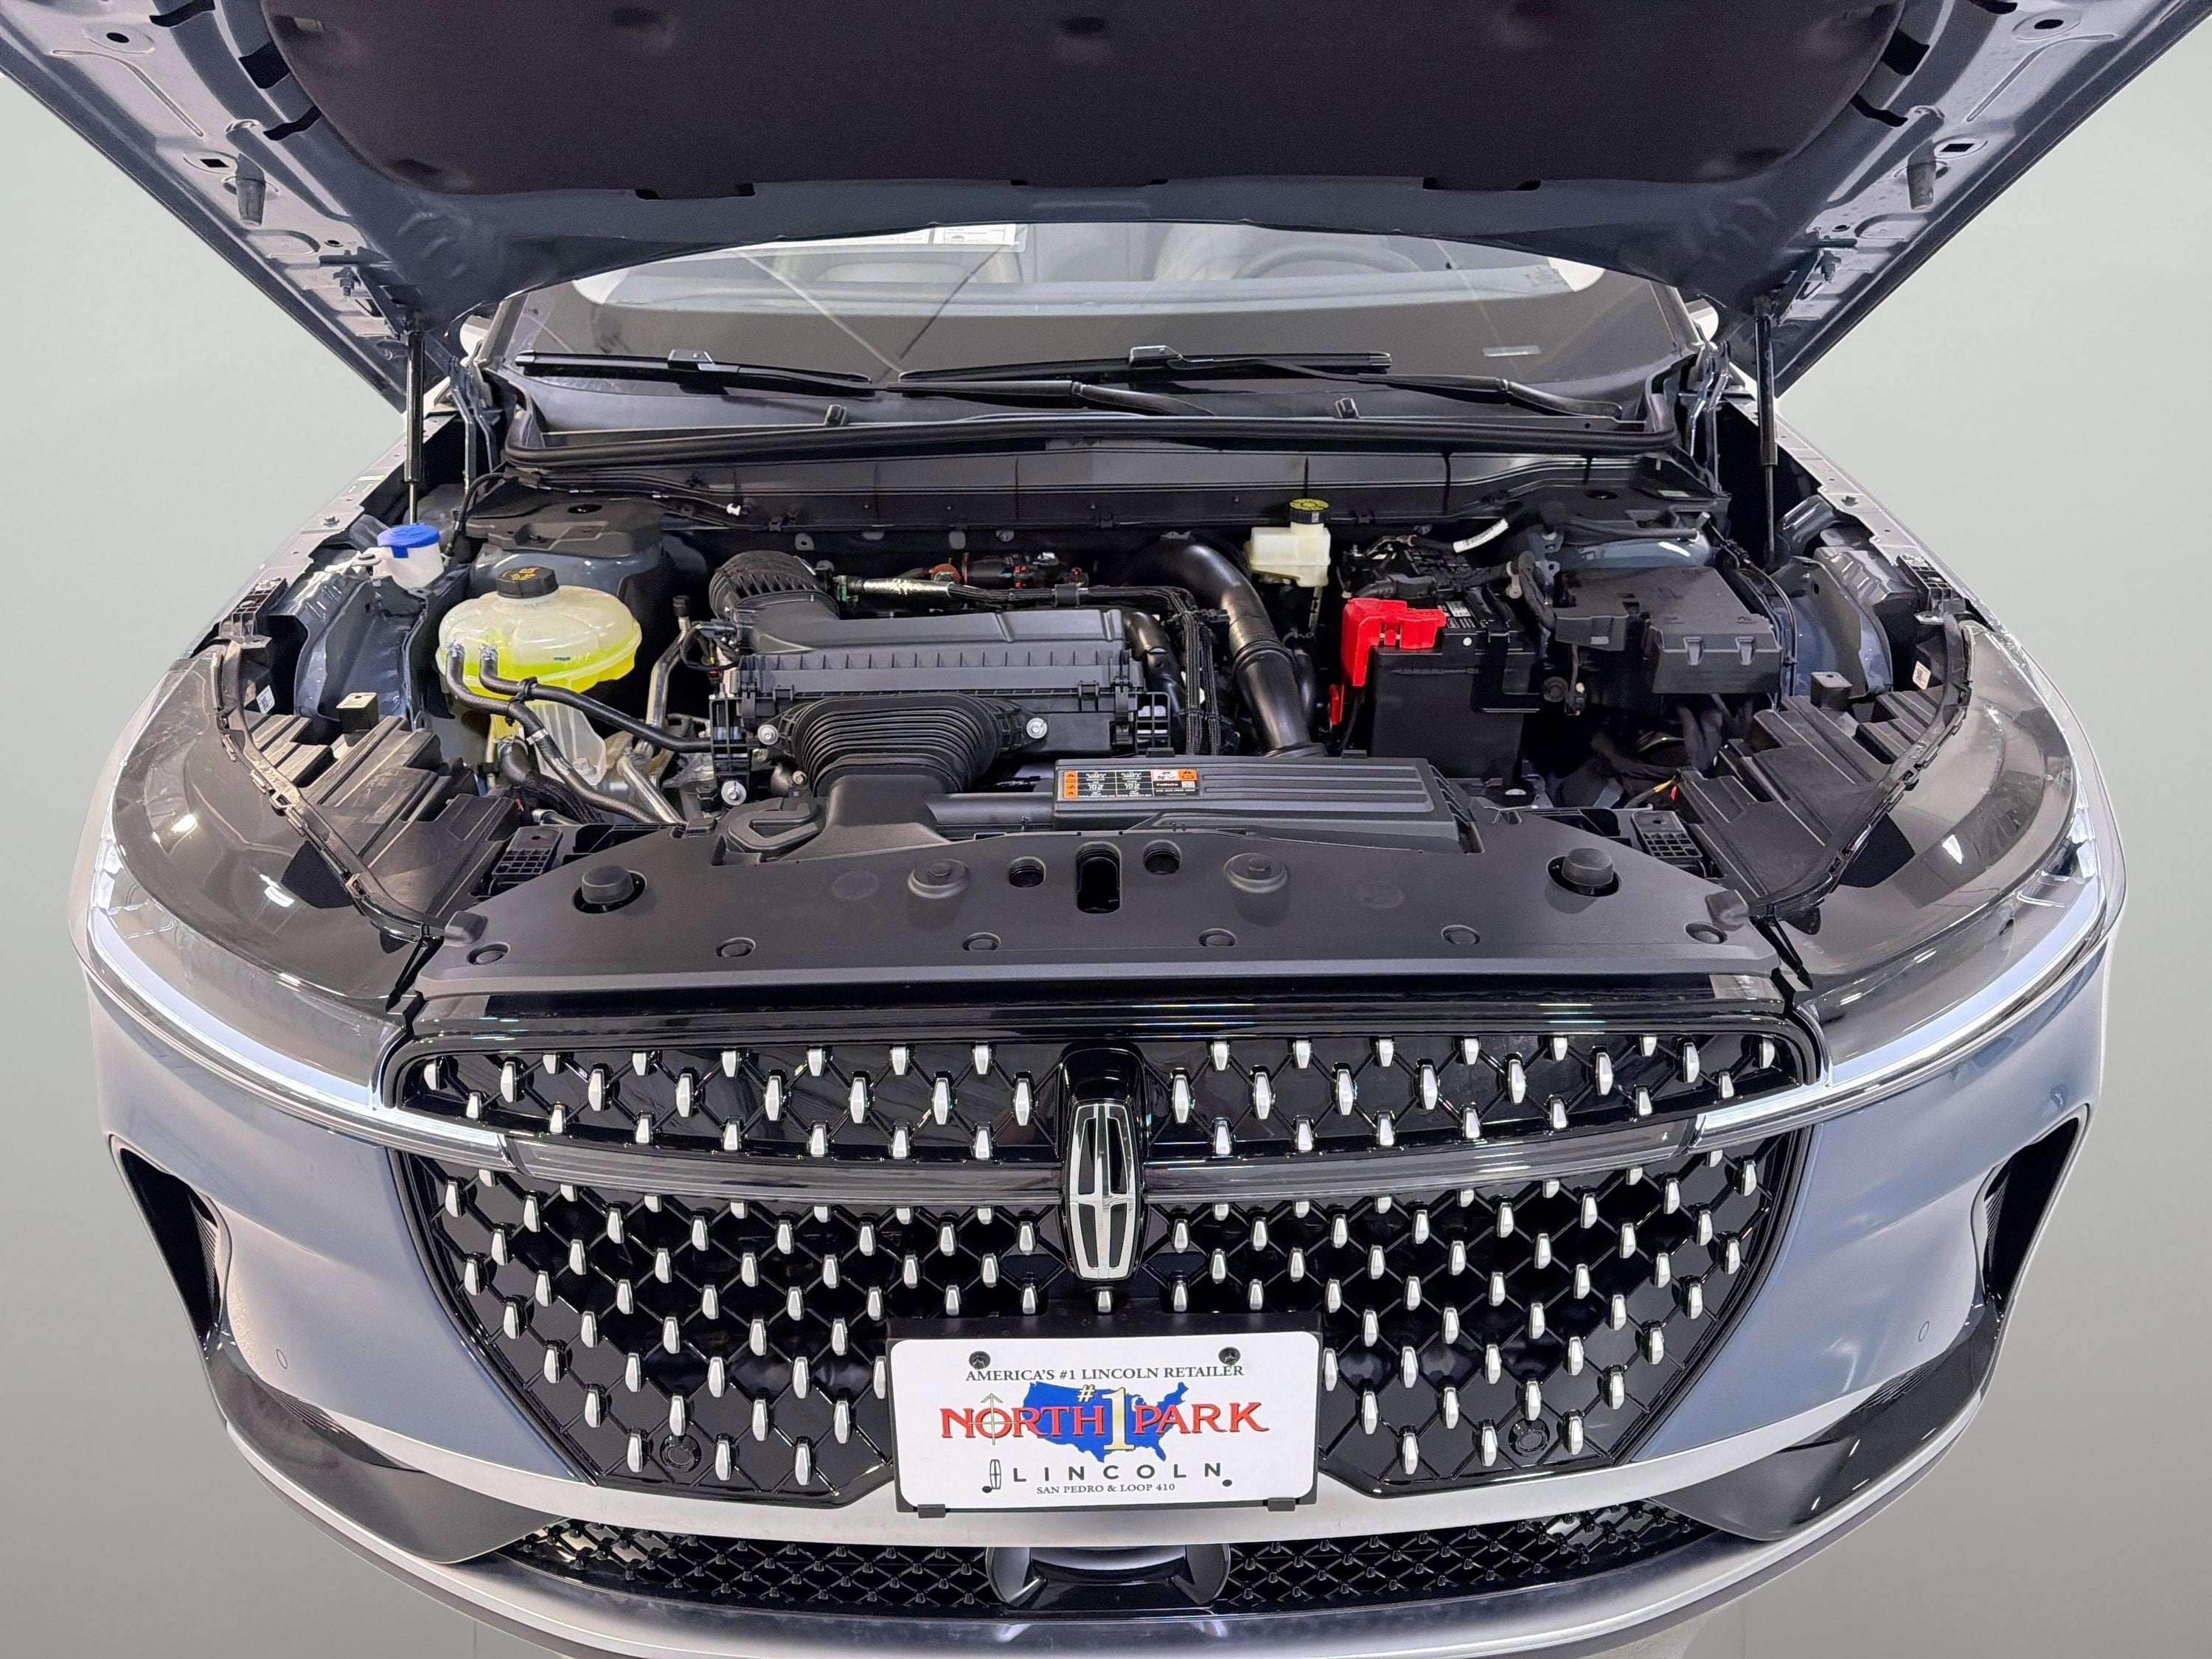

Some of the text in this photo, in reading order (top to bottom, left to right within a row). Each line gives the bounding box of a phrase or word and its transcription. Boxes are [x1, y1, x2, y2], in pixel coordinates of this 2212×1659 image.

[965, 1366, 1245, 1381] AMERICA'S #1 LINCOLN RETAILER
[939, 1402, 1270, 1439] NORTH PARK
[1013, 1462, 1221, 1482] LINCOLN
[1037, 1483, 1175, 1494] SAN PEDRO & LOOP 410
